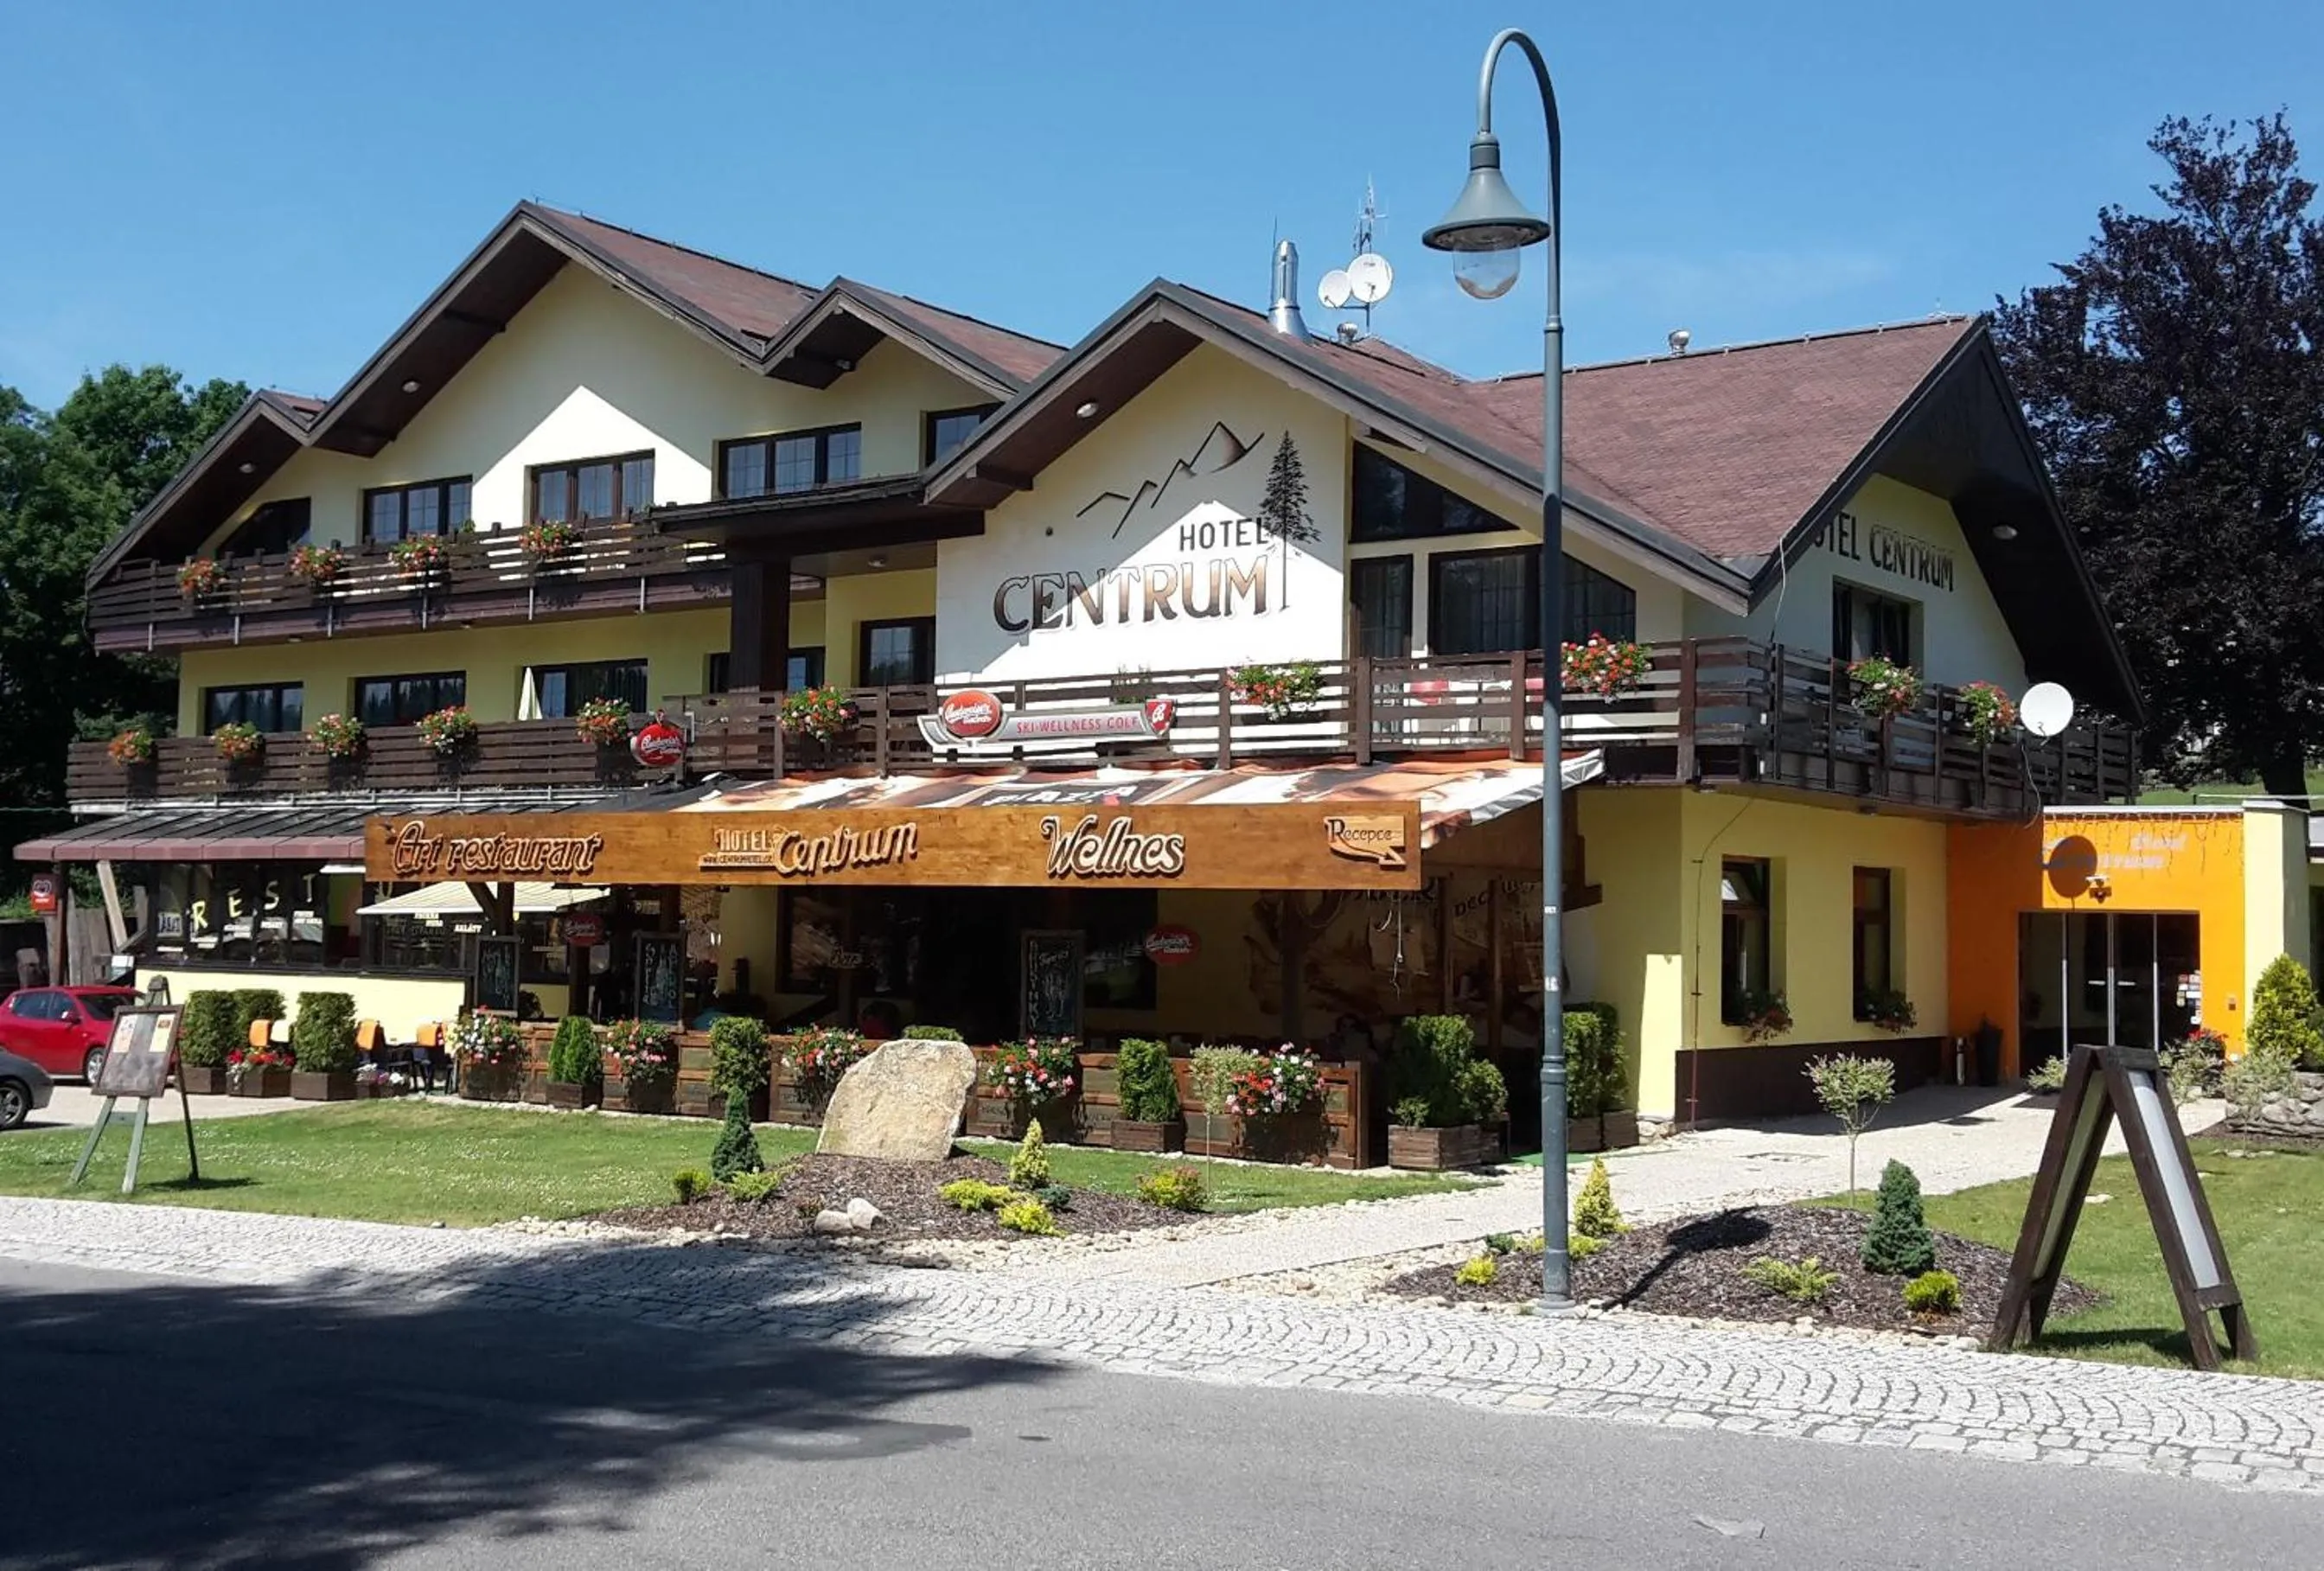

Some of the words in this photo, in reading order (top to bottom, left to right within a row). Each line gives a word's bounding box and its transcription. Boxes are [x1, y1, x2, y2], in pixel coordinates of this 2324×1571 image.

[1179, 517, 1270, 552] HOTEL
[1869, 524, 1955, 592] CENTRUM
[993, 554, 1268, 632] CENTRUM
[446, 833, 601, 872] restaurant
[714, 828, 772, 852] HOTEL
[775, 822, 917, 876] Centrum
[1041, 814, 1185, 875] Wellnes
[1327, 818, 1391, 846] Recepce
